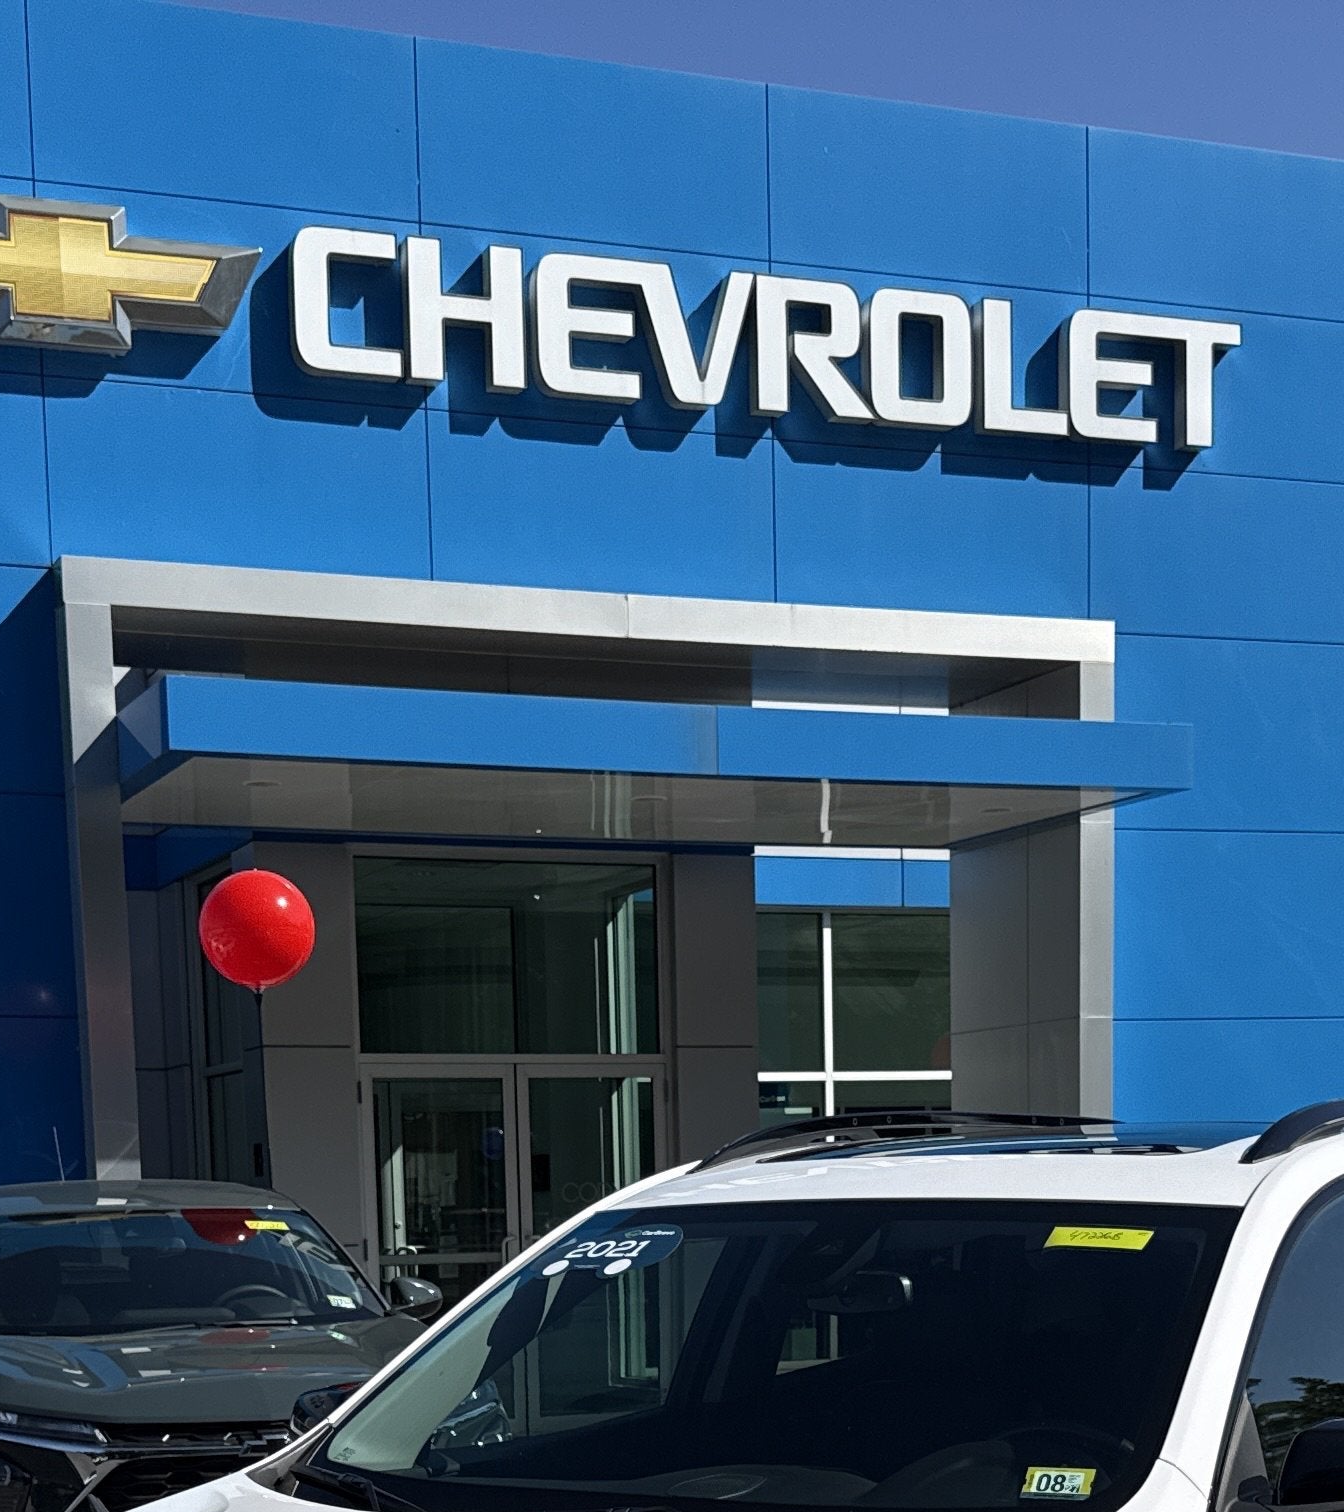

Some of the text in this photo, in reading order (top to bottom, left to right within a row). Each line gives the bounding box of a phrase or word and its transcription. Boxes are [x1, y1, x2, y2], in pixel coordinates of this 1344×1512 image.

[288, 224, 1242, 451] CHEVROLET
[564, 1240, 651, 1258] 2021
[1036, 1473, 1066, 1492] 08
